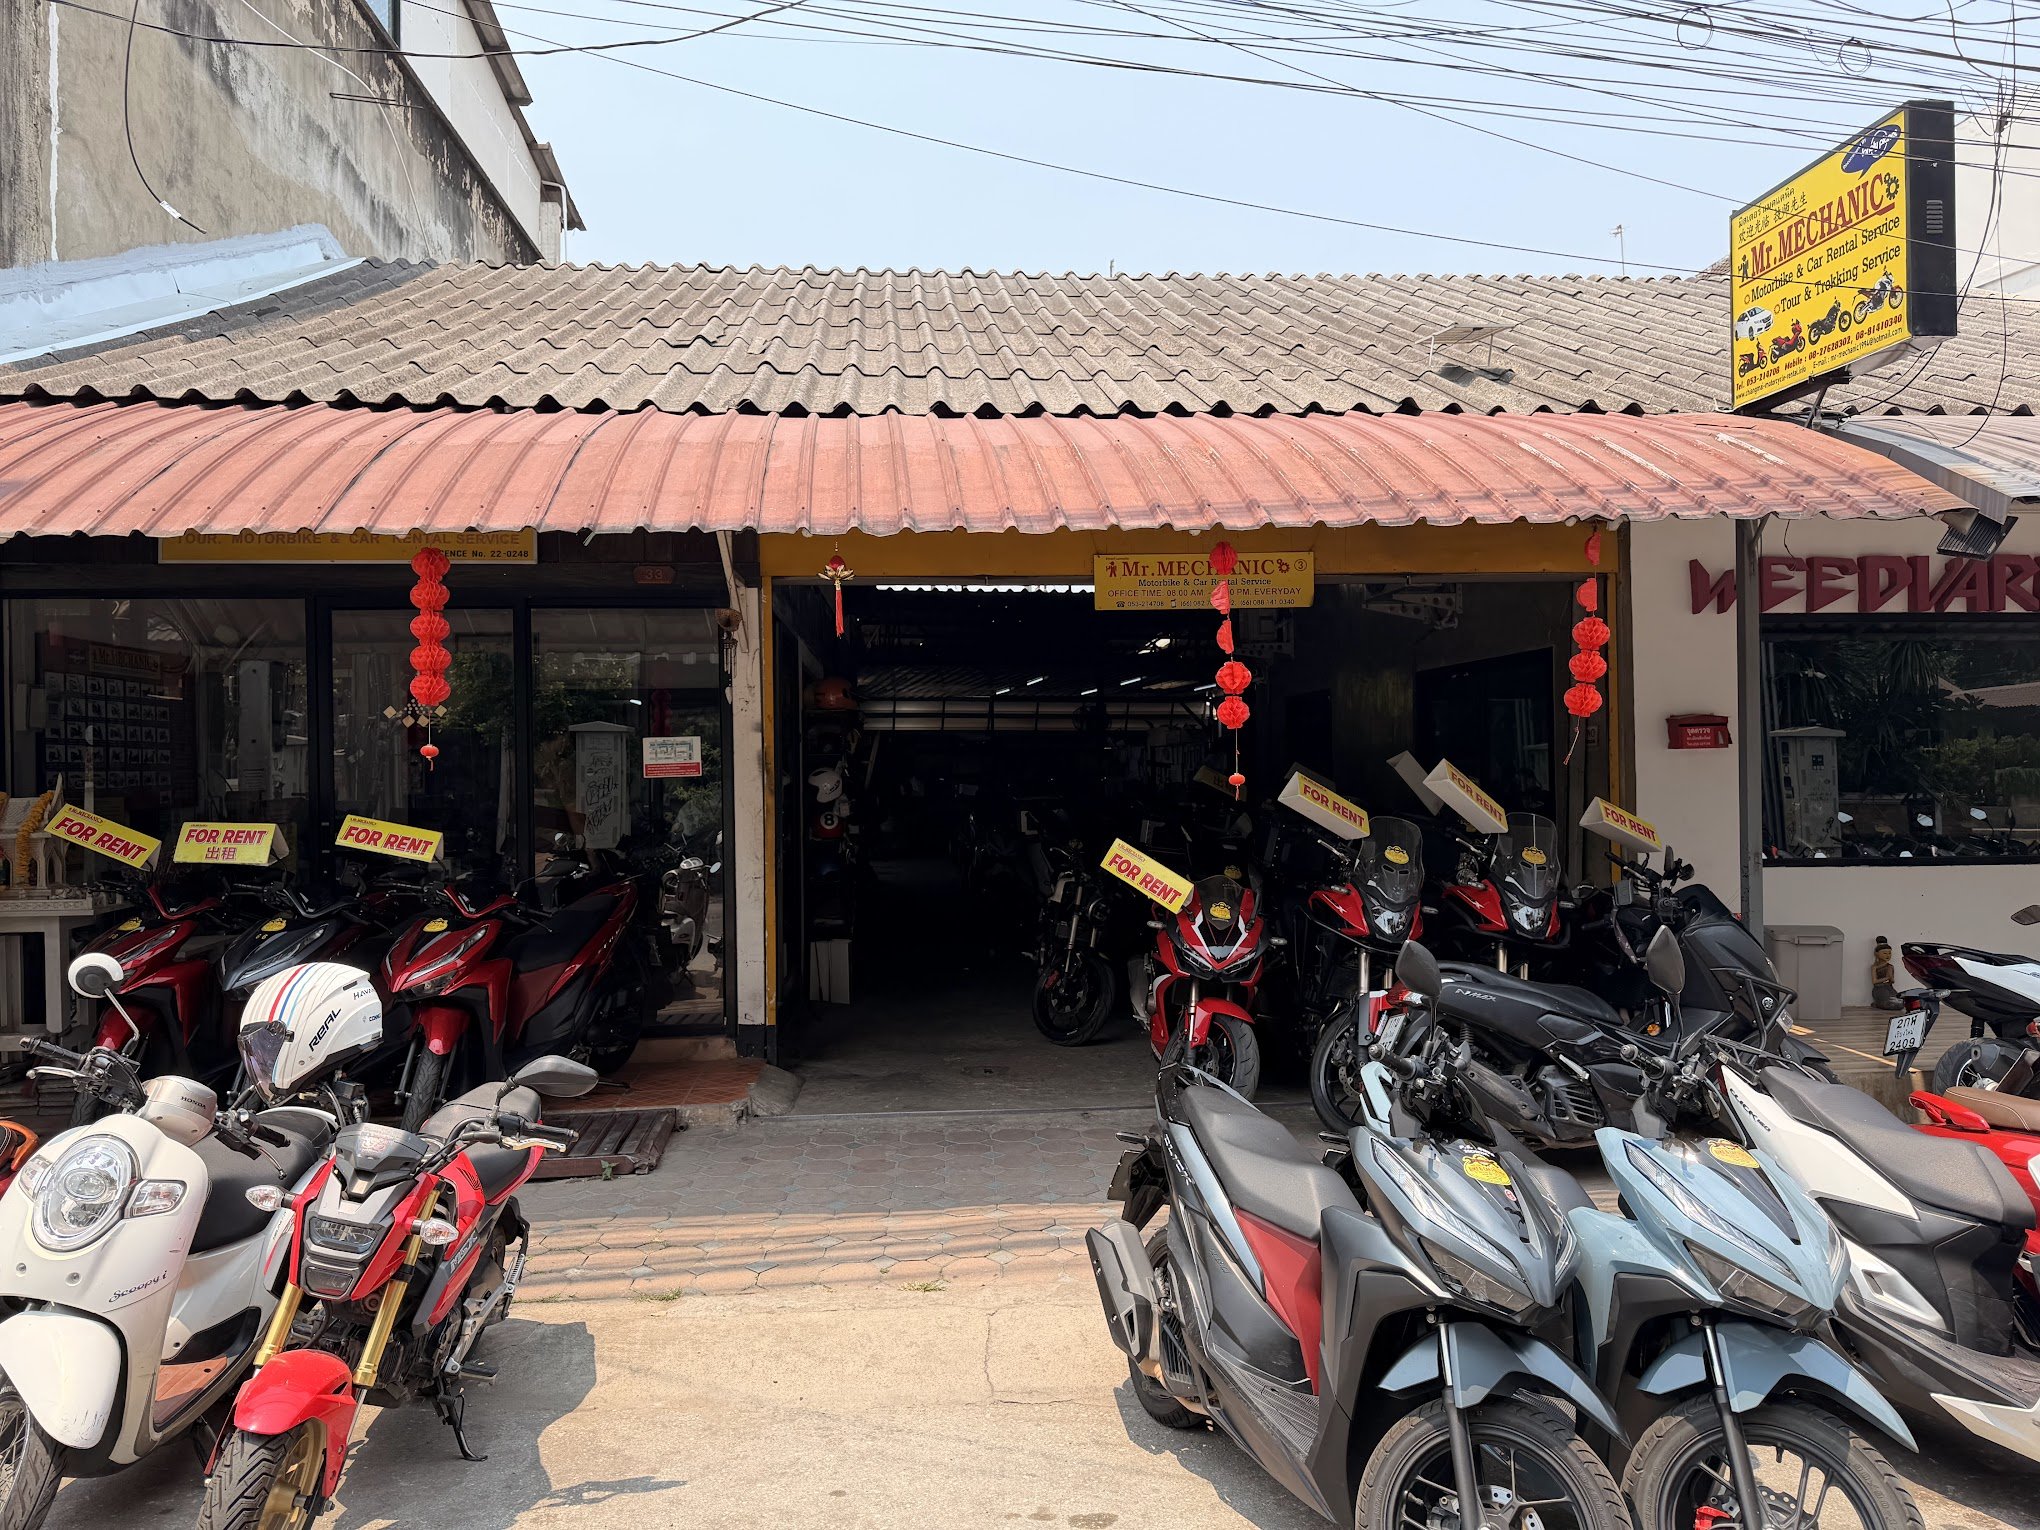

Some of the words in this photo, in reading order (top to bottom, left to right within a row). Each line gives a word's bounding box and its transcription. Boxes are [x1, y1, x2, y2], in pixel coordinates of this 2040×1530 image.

[1751, 173, 1883, 277] Mr.MECHANIC
[1751, 272, 1793, 302] Motorbike
[1797, 264, 1803, 278] &
[1807, 256, 1823, 272] Car
[1826, 234, 1857, 263] Rental
[1862, 216, 1900, 245] Service
[1781, 294, 1801, 311] Tour
[1804, 286, 1811, 301] &
[1815, 266, 1858, 296] Trekking
[1862, 245, 1900, 273] Service
[231, 531, 321, 544] MOTORBIKE
[330, 533, 339, 543] &
[350, 532, 380, 544] CAR
[456, 533, 520, 544] SERVICE
[1108, 589, 1139, 598] OFFICE
[1254, 587, 1302, 596] EVERYDAY
[1138, 579, 1180, 587] Motorbike
[1241, 577, 1272, 585] Service
[1690, 553, 2040, 615] WEEDVAR
[1303, 783, 1329, 808] FOR
[1332, 800, 1364, 827] RENT
[1451, 771, 1472, 797] FOR
[1476, 792, 1503, 822] RENT
[53, 816, 97, 842] FOR
[92, 832, 147, 861] RENT
[185, 829, 220, 844] FOR
[221, 830, 268, 845] RENT
[343, 824, 383, 847] FOR
[382, 833, 434, 856] RENT
[1603, 806, 1627, 828] FOR
[1629, 819, 1656, 841] RENT
[205, 846, 236, 860] 出租
[1107, 853, 1142, 881] FOR
[1138, 872, 1182, 905] RENT
[308, 1009, 342, 1053] REAL
[1889, 1038, 1915, 1051] 2409
[181, 1096, 206, 1109] HONDA
[109, 1278, 160, 1303] Scoopy
